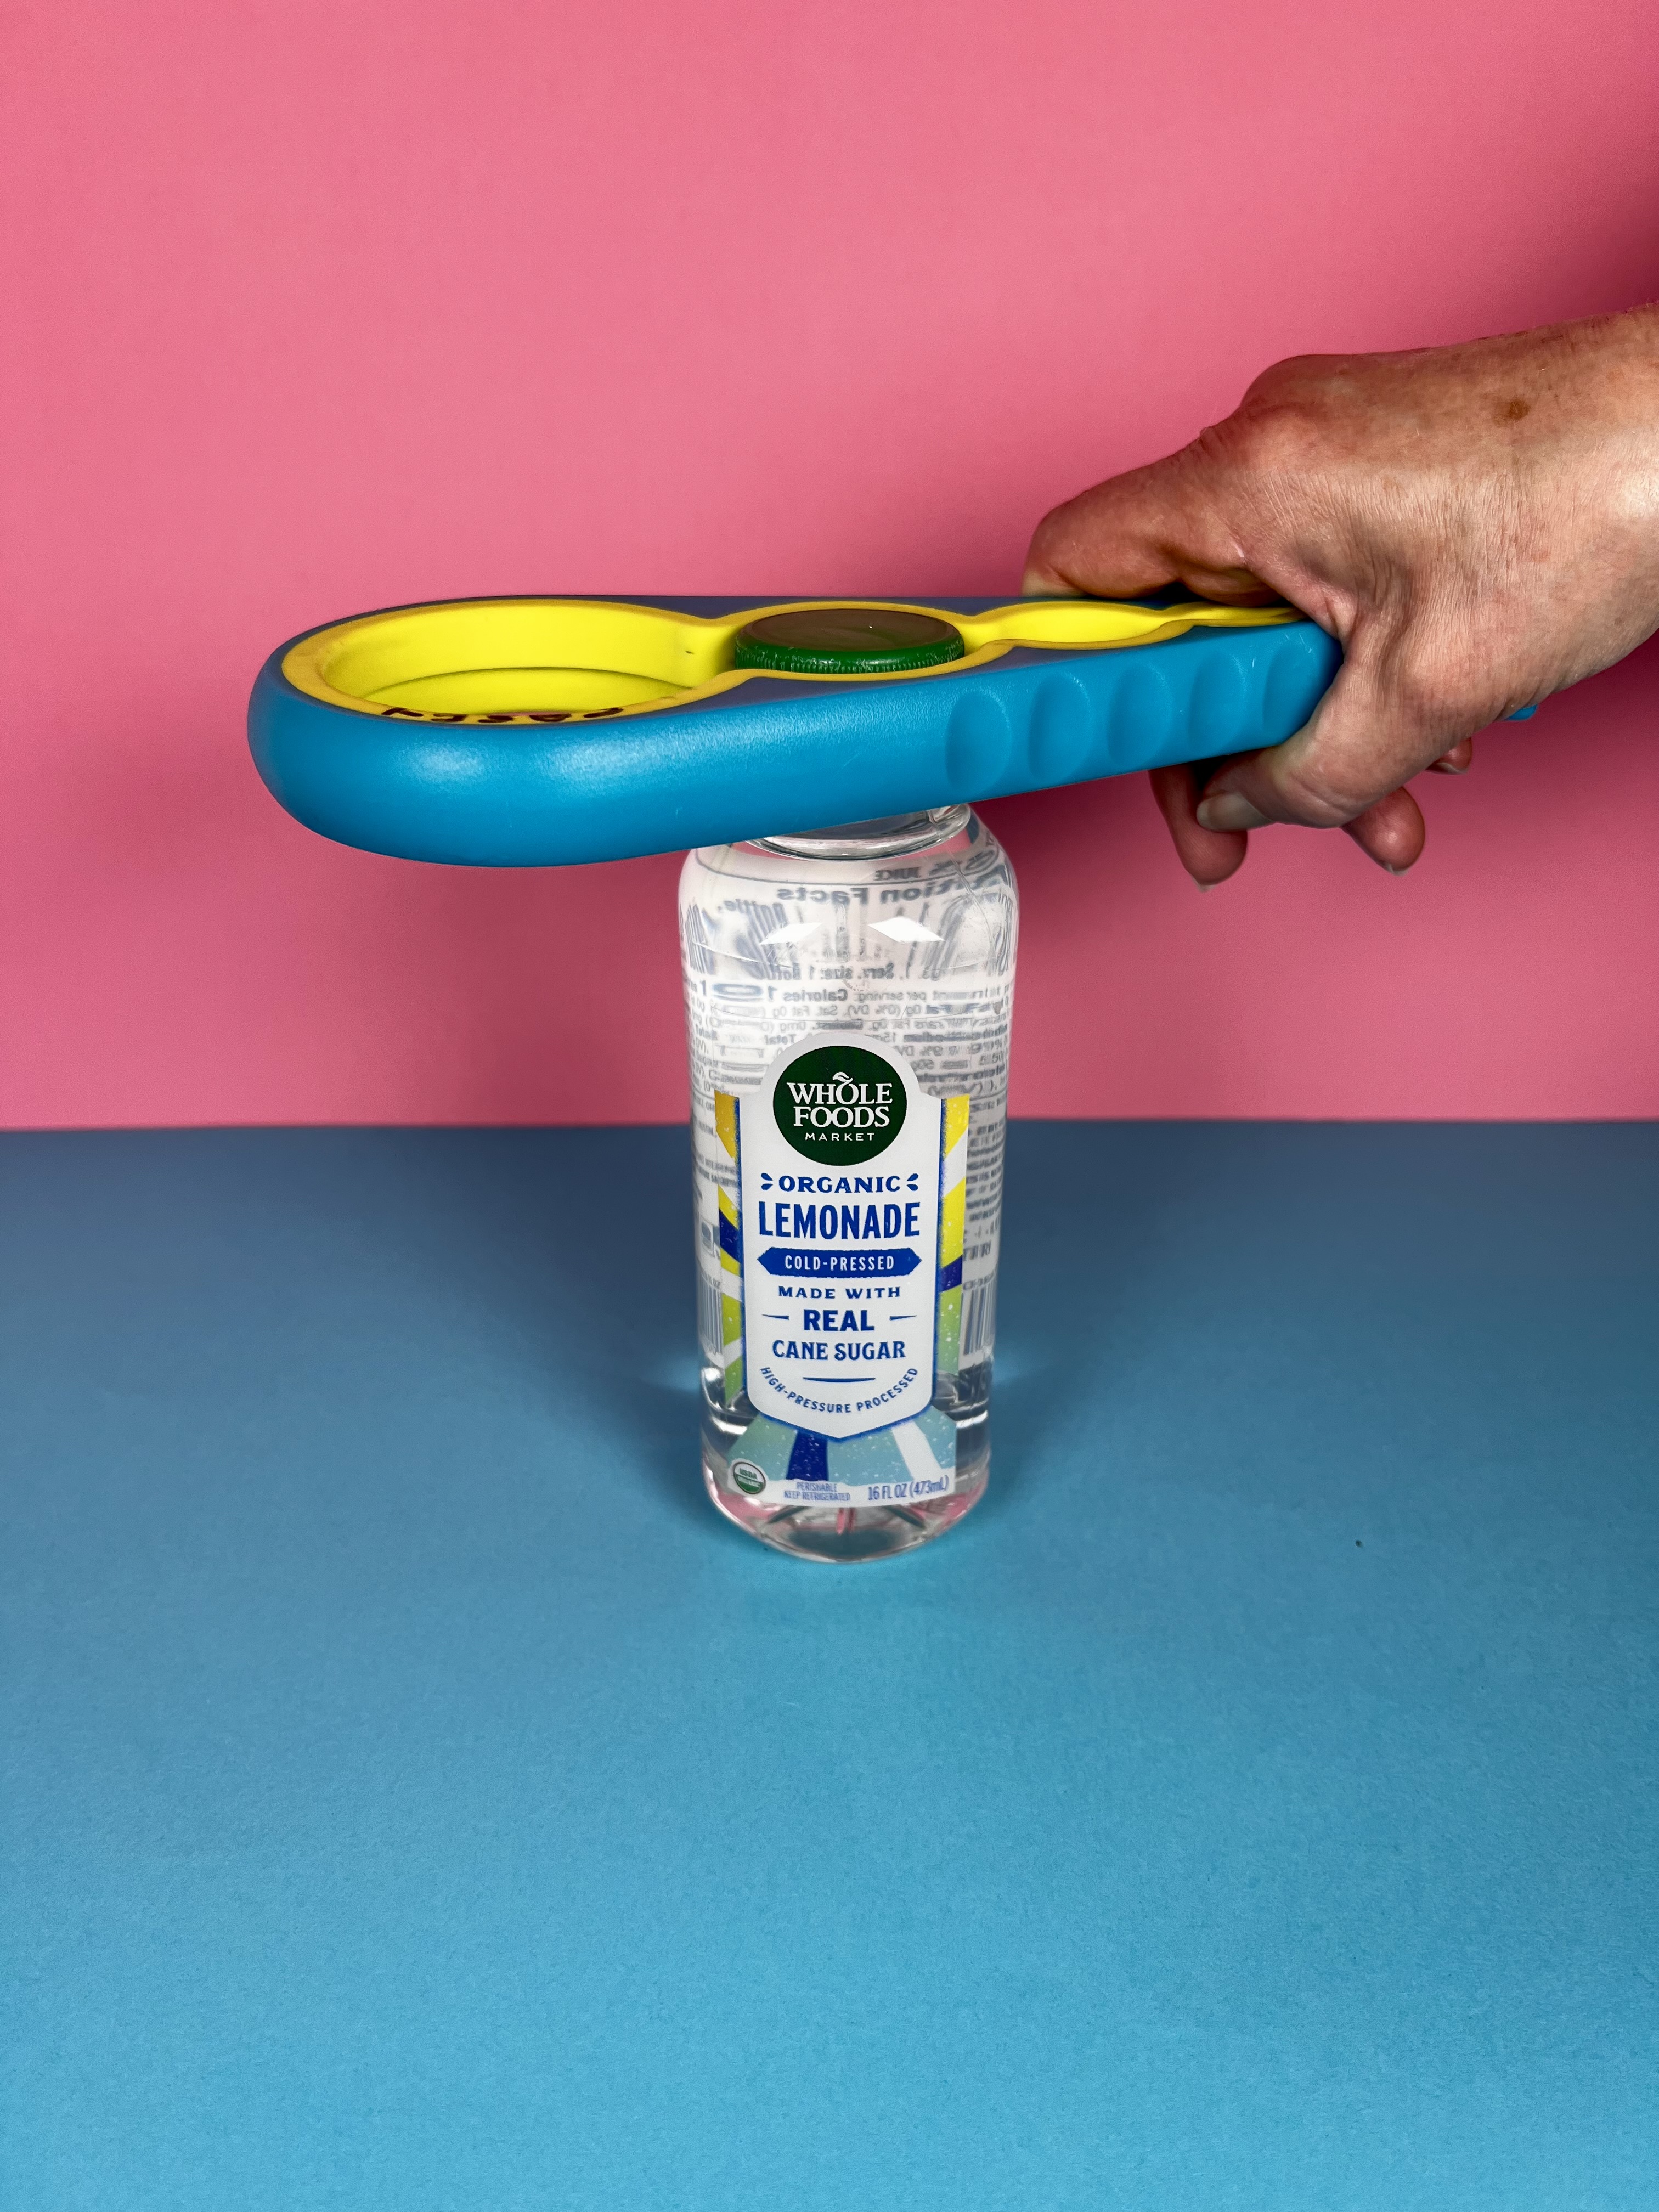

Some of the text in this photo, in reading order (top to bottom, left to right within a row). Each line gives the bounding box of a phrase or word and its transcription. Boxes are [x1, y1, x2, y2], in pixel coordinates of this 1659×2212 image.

[787, 1082, 893, 1105] WHOLE
[793, 1105, 890, 1128] FOODS
[805, 1132, 875, 1141] MARKET
[778, 1175, 901, 1193] ORGANIC
[759, 1200, 921, 1240] LEMONADE
[785, 1255, 895, 1271] COLD-PRESSED
[778, 1285, 901, 1299] MADE WITH
[803, 1308, 875, 1331] REAL
[772, 1340, 906, 1361] CANE SUGAR
[760, 1367, 918, 1413] HIGH-PRESSURE PROCESSED
[783, 1490, 851, 1502] KEEP REFRIGERATED
[796, 1482, 838, 1492] PERISHABLE
[867, 1486, 880, 1500] 16
[882, 1485, 893, 1499] FL
[894, 1483, 907, 1498] OZ
